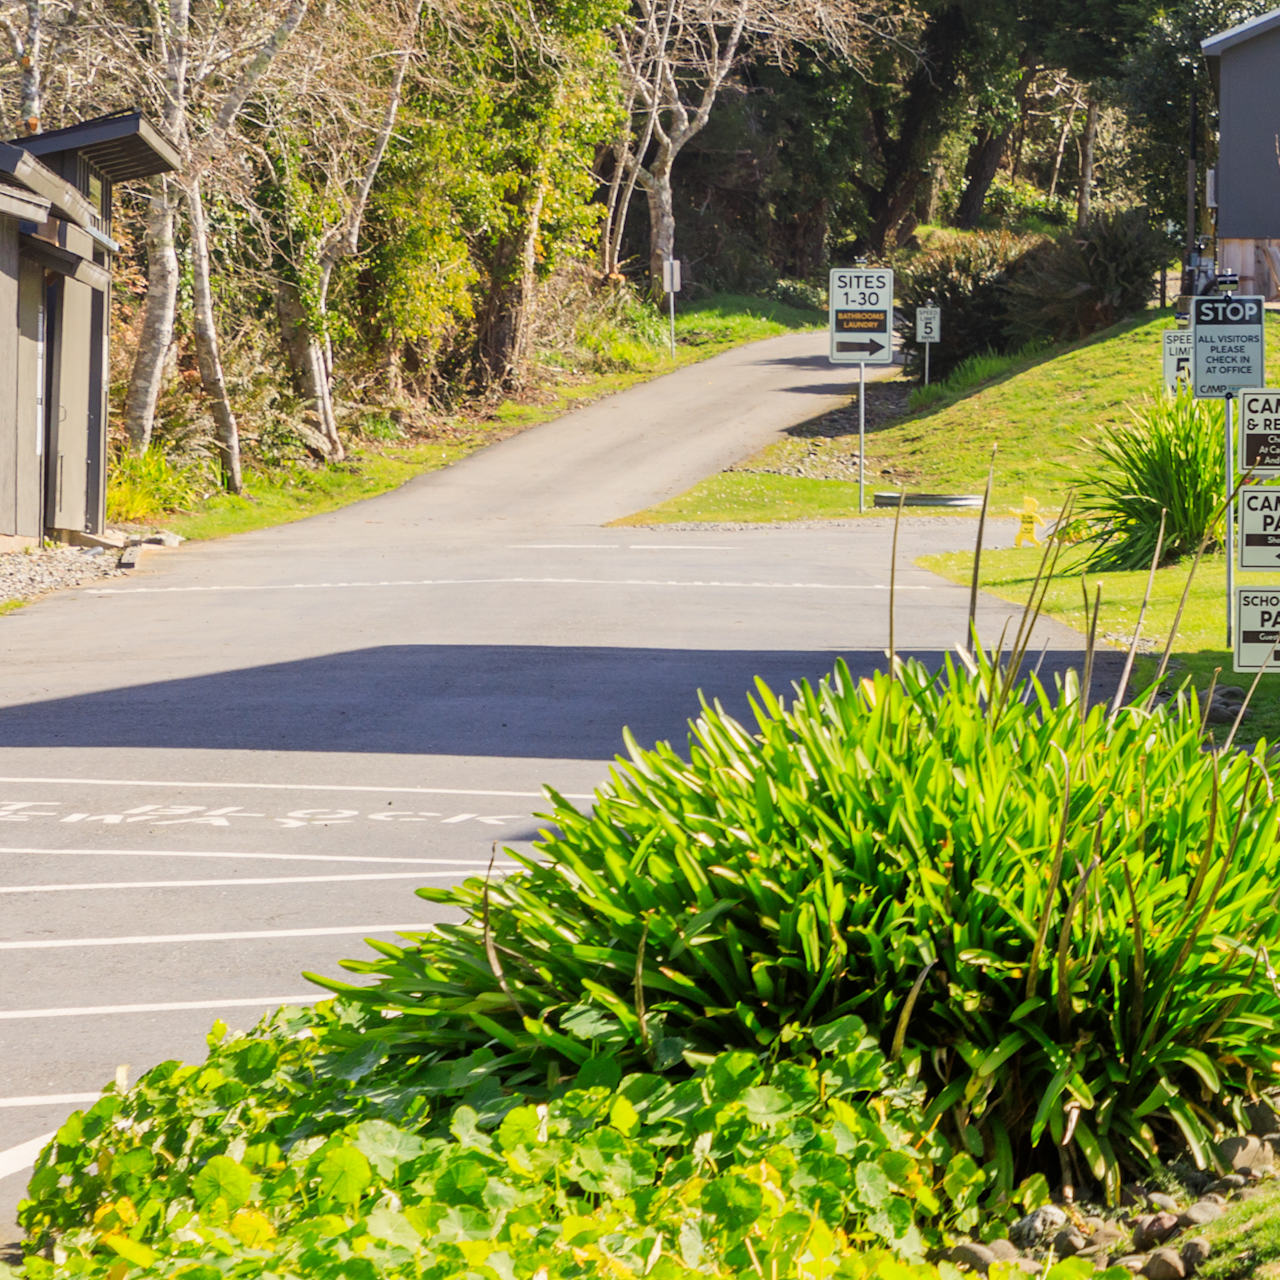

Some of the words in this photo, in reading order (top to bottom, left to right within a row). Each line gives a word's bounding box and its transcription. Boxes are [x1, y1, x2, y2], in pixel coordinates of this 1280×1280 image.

[837, 275, 886, 289] SITES
[843, 292, 879, 306] 1-30
[838, 312, 885, 320] BATHROOMS
[1200, 303, 1258, 321] STOP
[843, 321, 879, 329] LAUNDRY
[924, 322, 933, 335] 5
[1166, 335, 1193, 345] SPEE
[1198, 335, 1216, 343] ALL
[1217, 335, 1260, 343] VISITORS
[1210, 346, 1246, 354] PLEASE
[1206, 356, 1238, 364] CHECK
[1240, 356, 1251, 364] IN
[1176, 357, 1191, 383] 5
[1206, 366, 1217, 374] AT
[1219, 366, 1252, 374] OFFICE
[1200, 385, 1228, 393] CAMP
[1247, 418, 1259, 431] &
[1259, 446, 1268, 454] At
[1264, 456, 1280, 464] And
